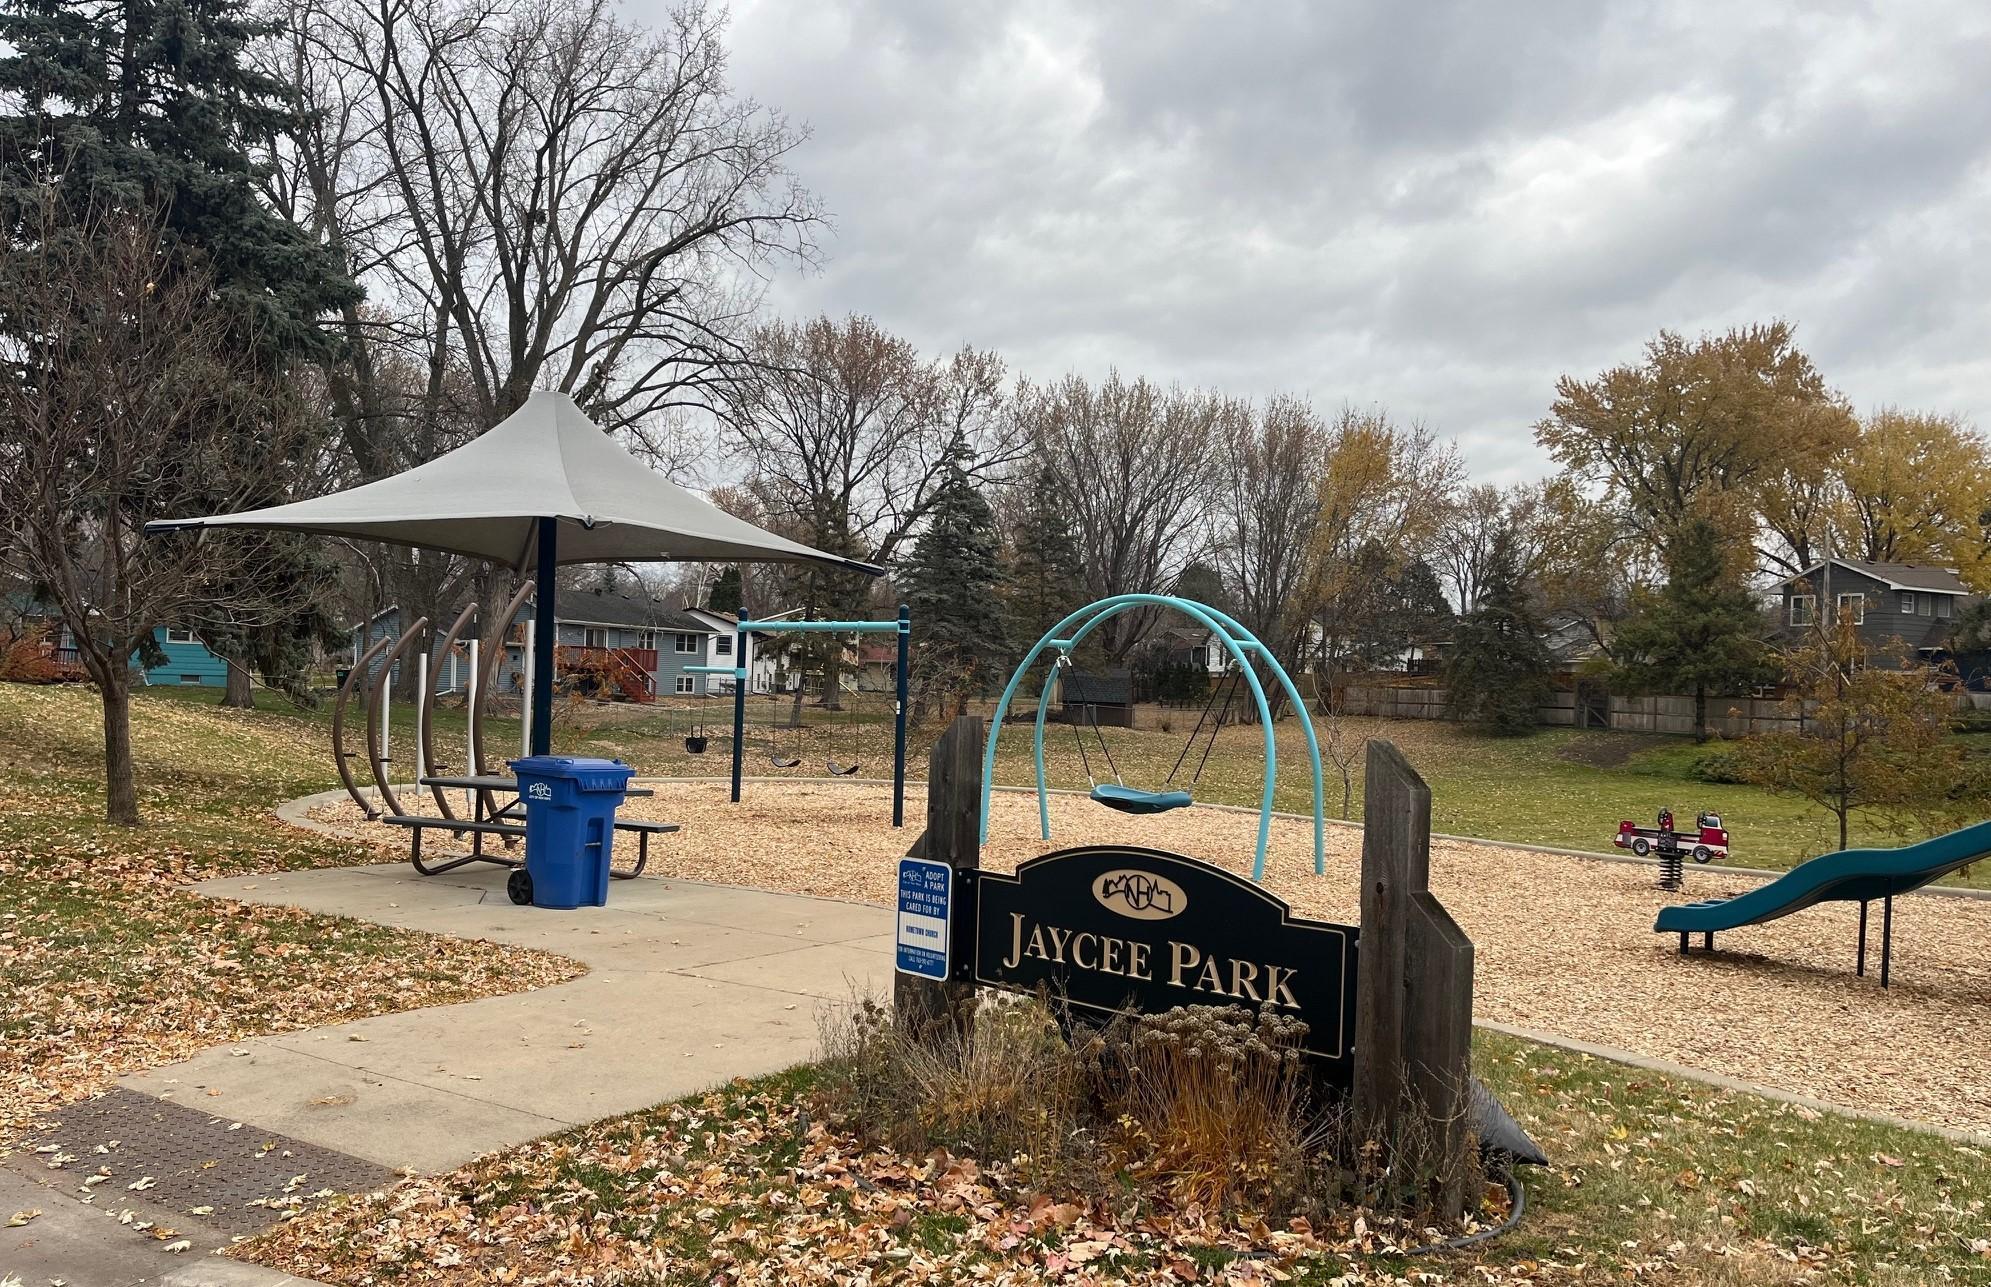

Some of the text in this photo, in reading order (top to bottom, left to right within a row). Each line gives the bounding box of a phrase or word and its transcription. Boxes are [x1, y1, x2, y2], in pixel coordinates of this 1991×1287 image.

[925, 870, 945, 882] ADOPT
[924, 880, 928, 889] A
[929, 881, 945, 892] PARK
[900, 889, 947, 906] THIS PARK IS BEING
[906, 901, 940, 916] CARED FOR BY
[1002, 912, 1303, 1010] JAYCEE PARK
